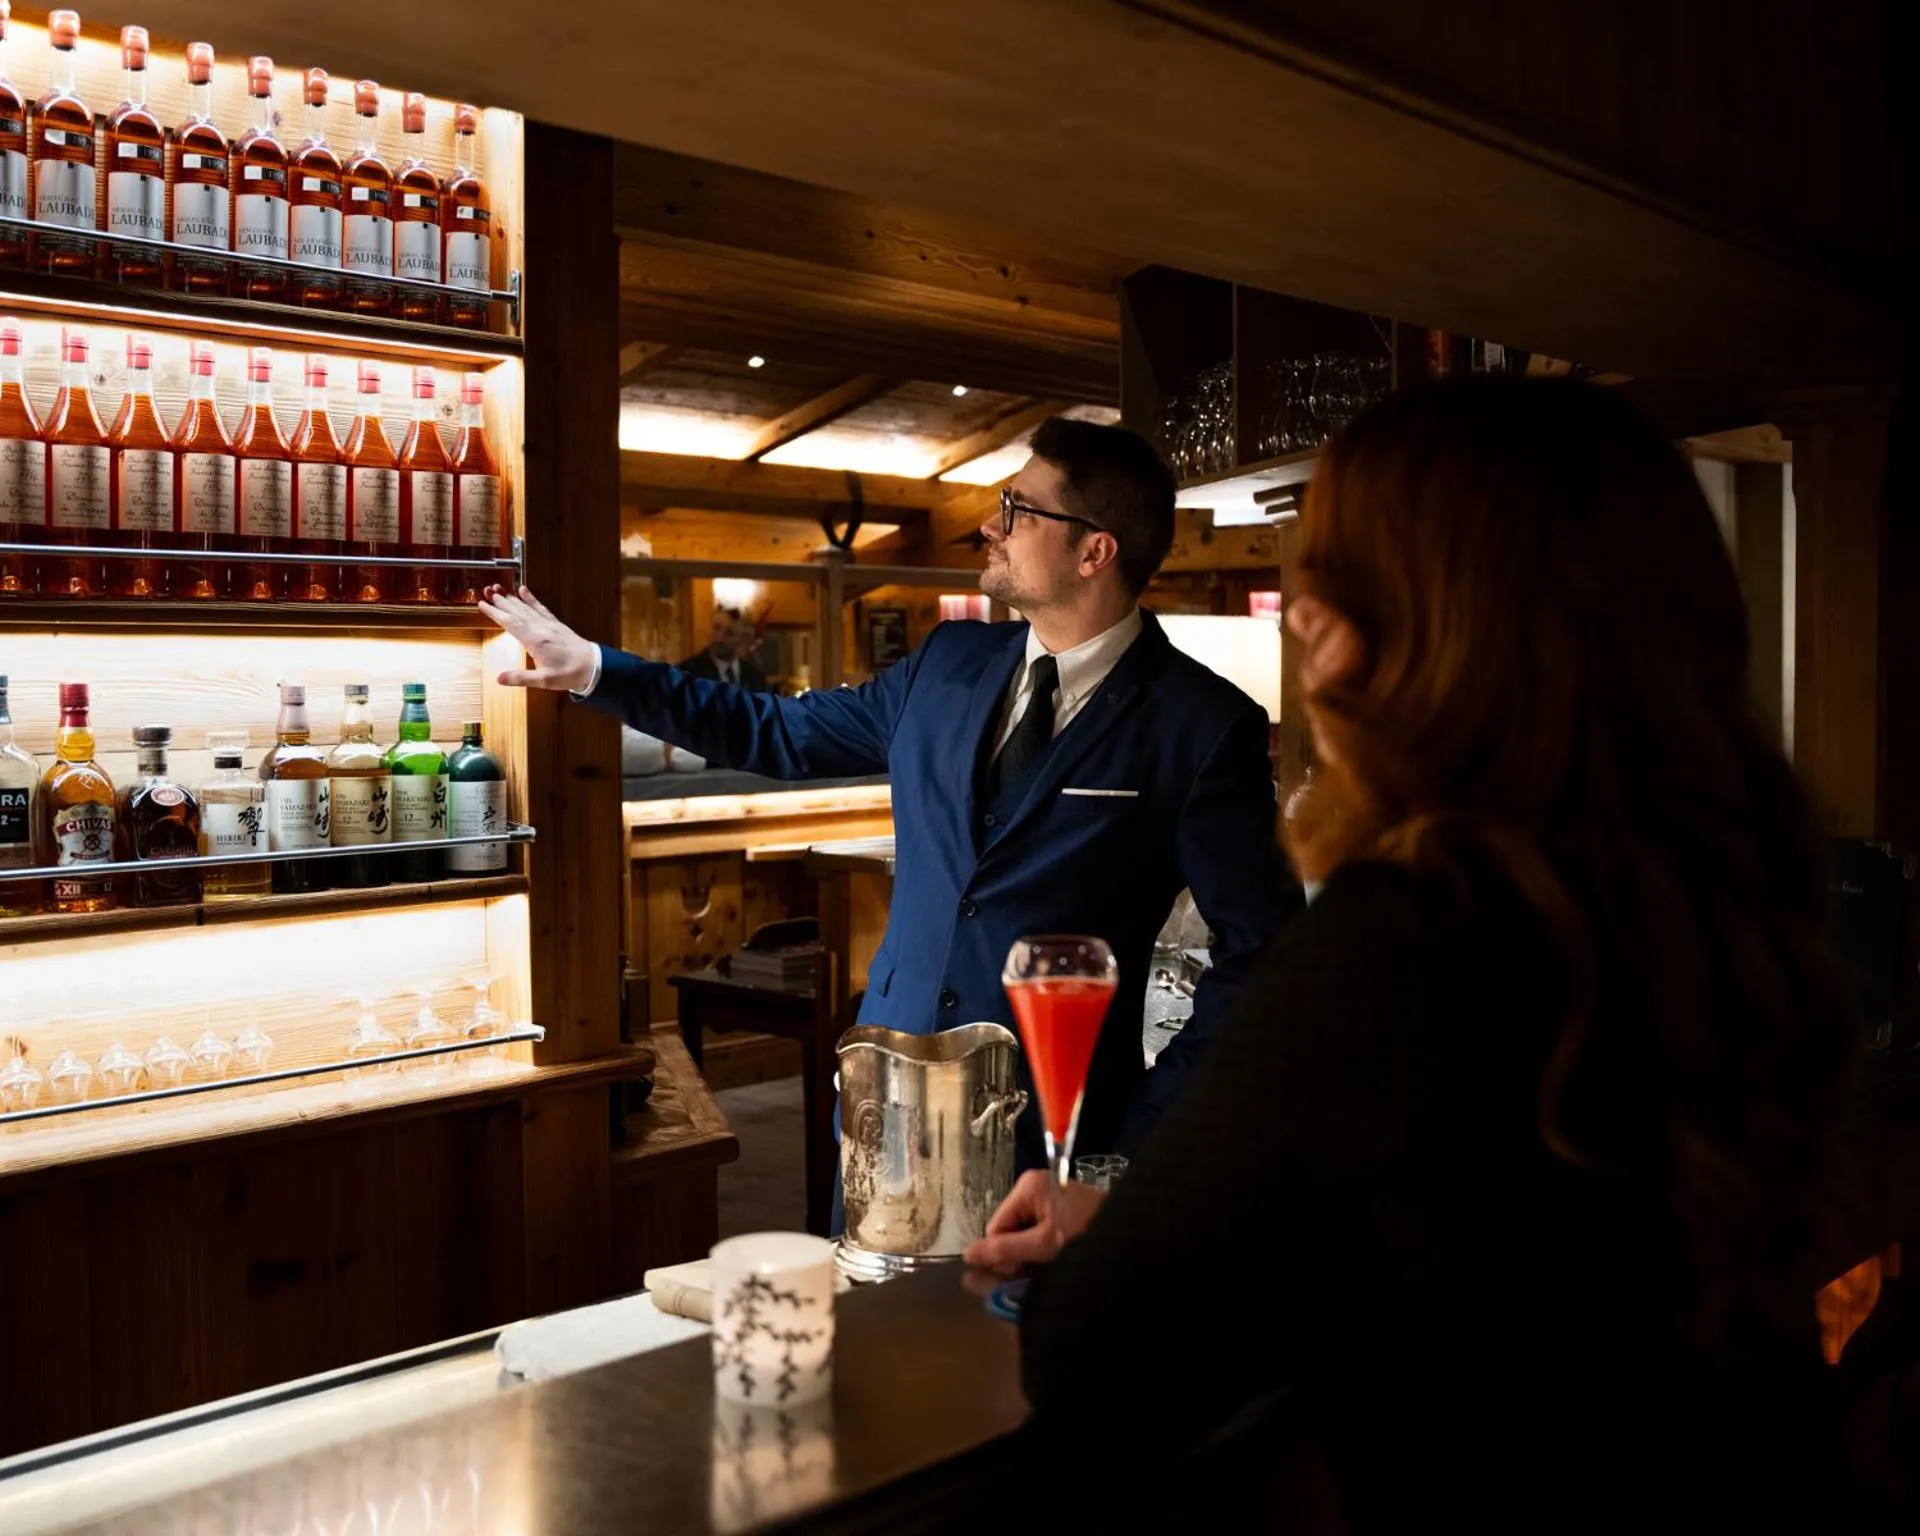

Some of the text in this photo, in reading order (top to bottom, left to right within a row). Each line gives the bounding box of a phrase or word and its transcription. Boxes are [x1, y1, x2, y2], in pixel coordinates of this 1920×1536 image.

[111, 213, 163, 230] LAUBAD
[177, 223, 227, 238] LAUBAD
[346, 252, 391, 266] LAUBAD
[397, 258, 440, 272] LAUBAD
[65, 818, 112, 832] CHIVAS
[62, 884, 81, 895] XII
